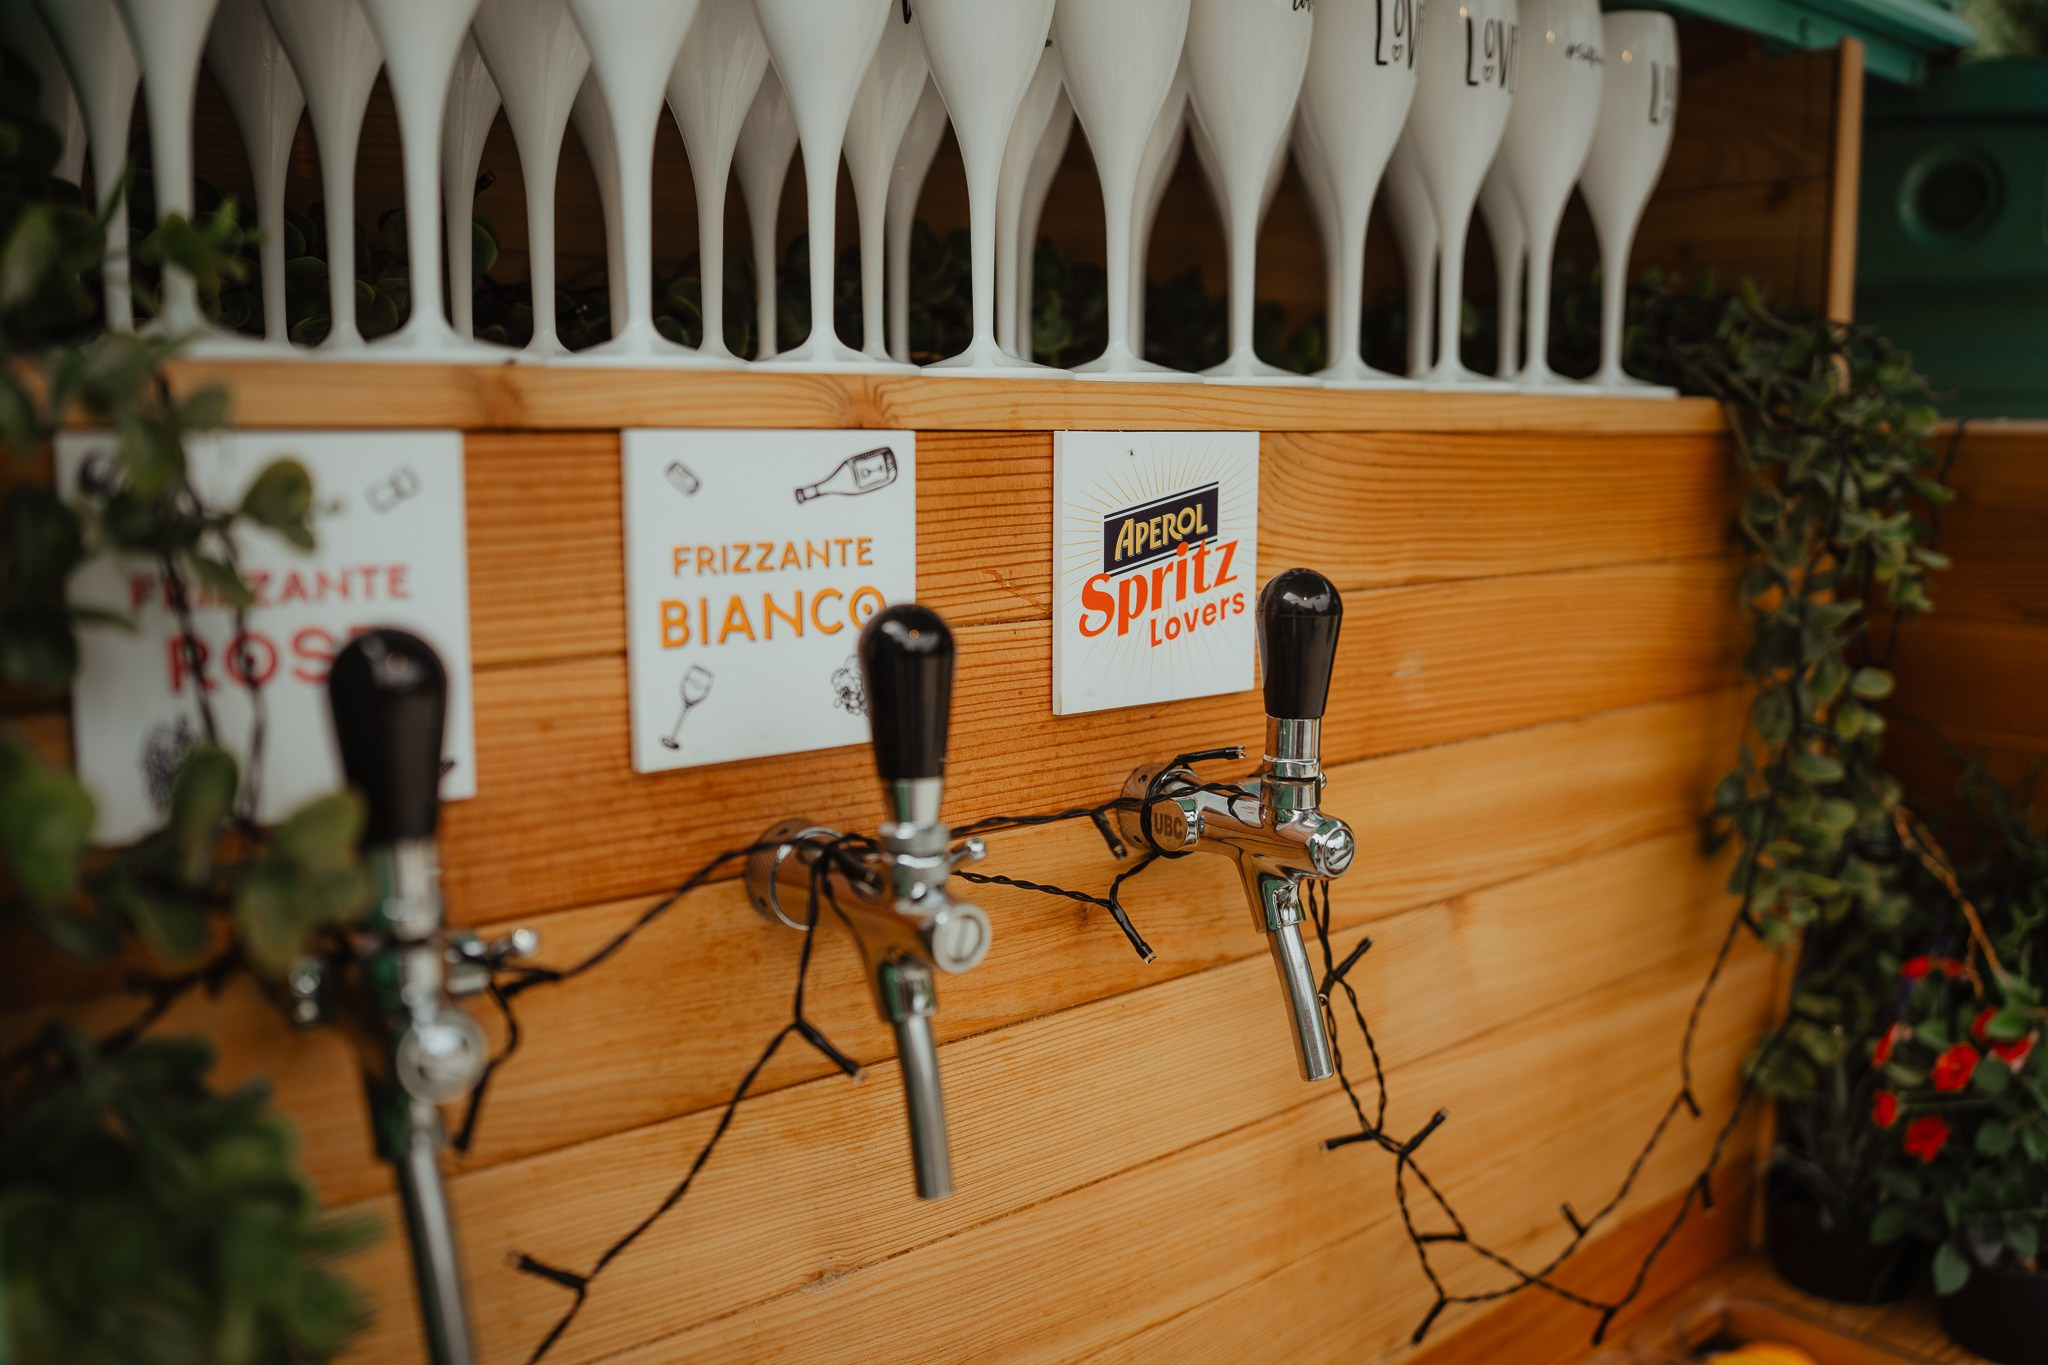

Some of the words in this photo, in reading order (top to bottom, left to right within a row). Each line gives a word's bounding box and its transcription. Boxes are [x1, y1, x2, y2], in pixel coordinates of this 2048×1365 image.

[671, 536, 874, 578] FRIZZANTE
[1114, 503, 1208, 562] APEROL
[659, 585, 886, 650] BIANCO
[1078, 538, 1239, 638] Spritz
[1150, 591, 1246, 648] Lovers
[166, 624, 378, 695] ROS
[1154, 811, 1184, 839] UBC
